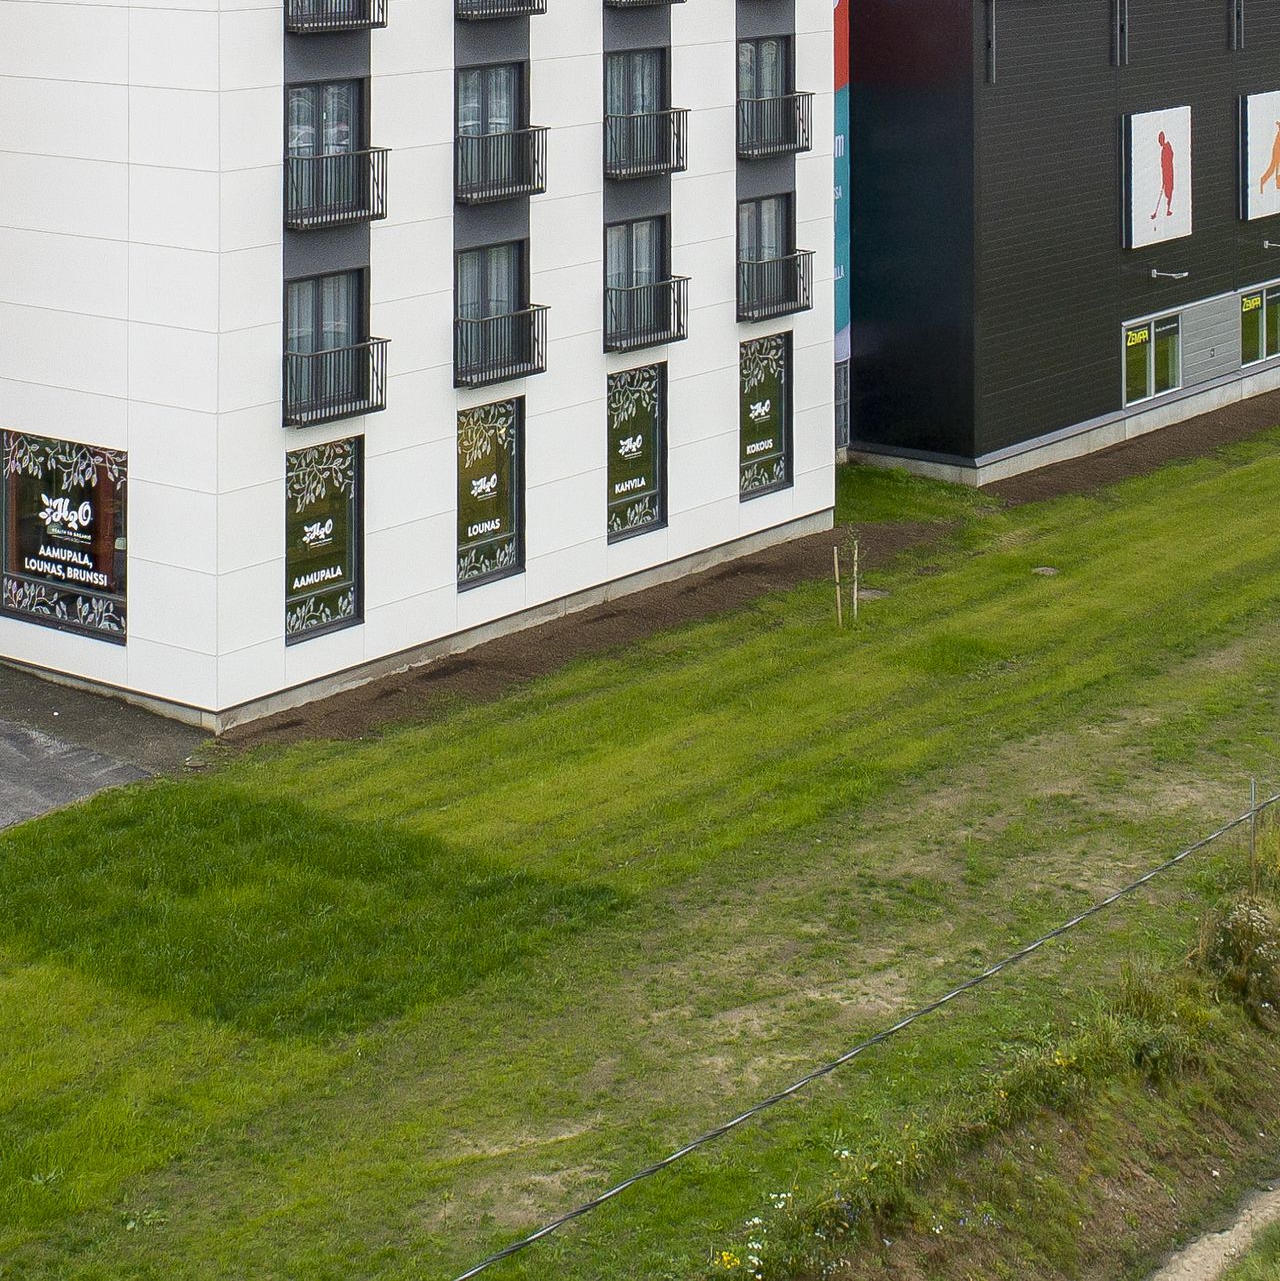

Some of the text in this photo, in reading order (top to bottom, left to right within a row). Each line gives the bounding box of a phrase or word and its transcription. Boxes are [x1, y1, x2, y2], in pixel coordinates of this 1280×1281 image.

[746, 439, 773, 455] KOKOUS
[614, 476, 646, 494] KAHVILA
[50, 497, 92, 530] H2O
[467, 519, 501, 537] LOUNAS
[38, 544, 94, 569] AAMUPALA,
[24, 557, 108, 587] LOUNAS, BRUNSSI
[292, 565, 343, 590] AAMUPALA
